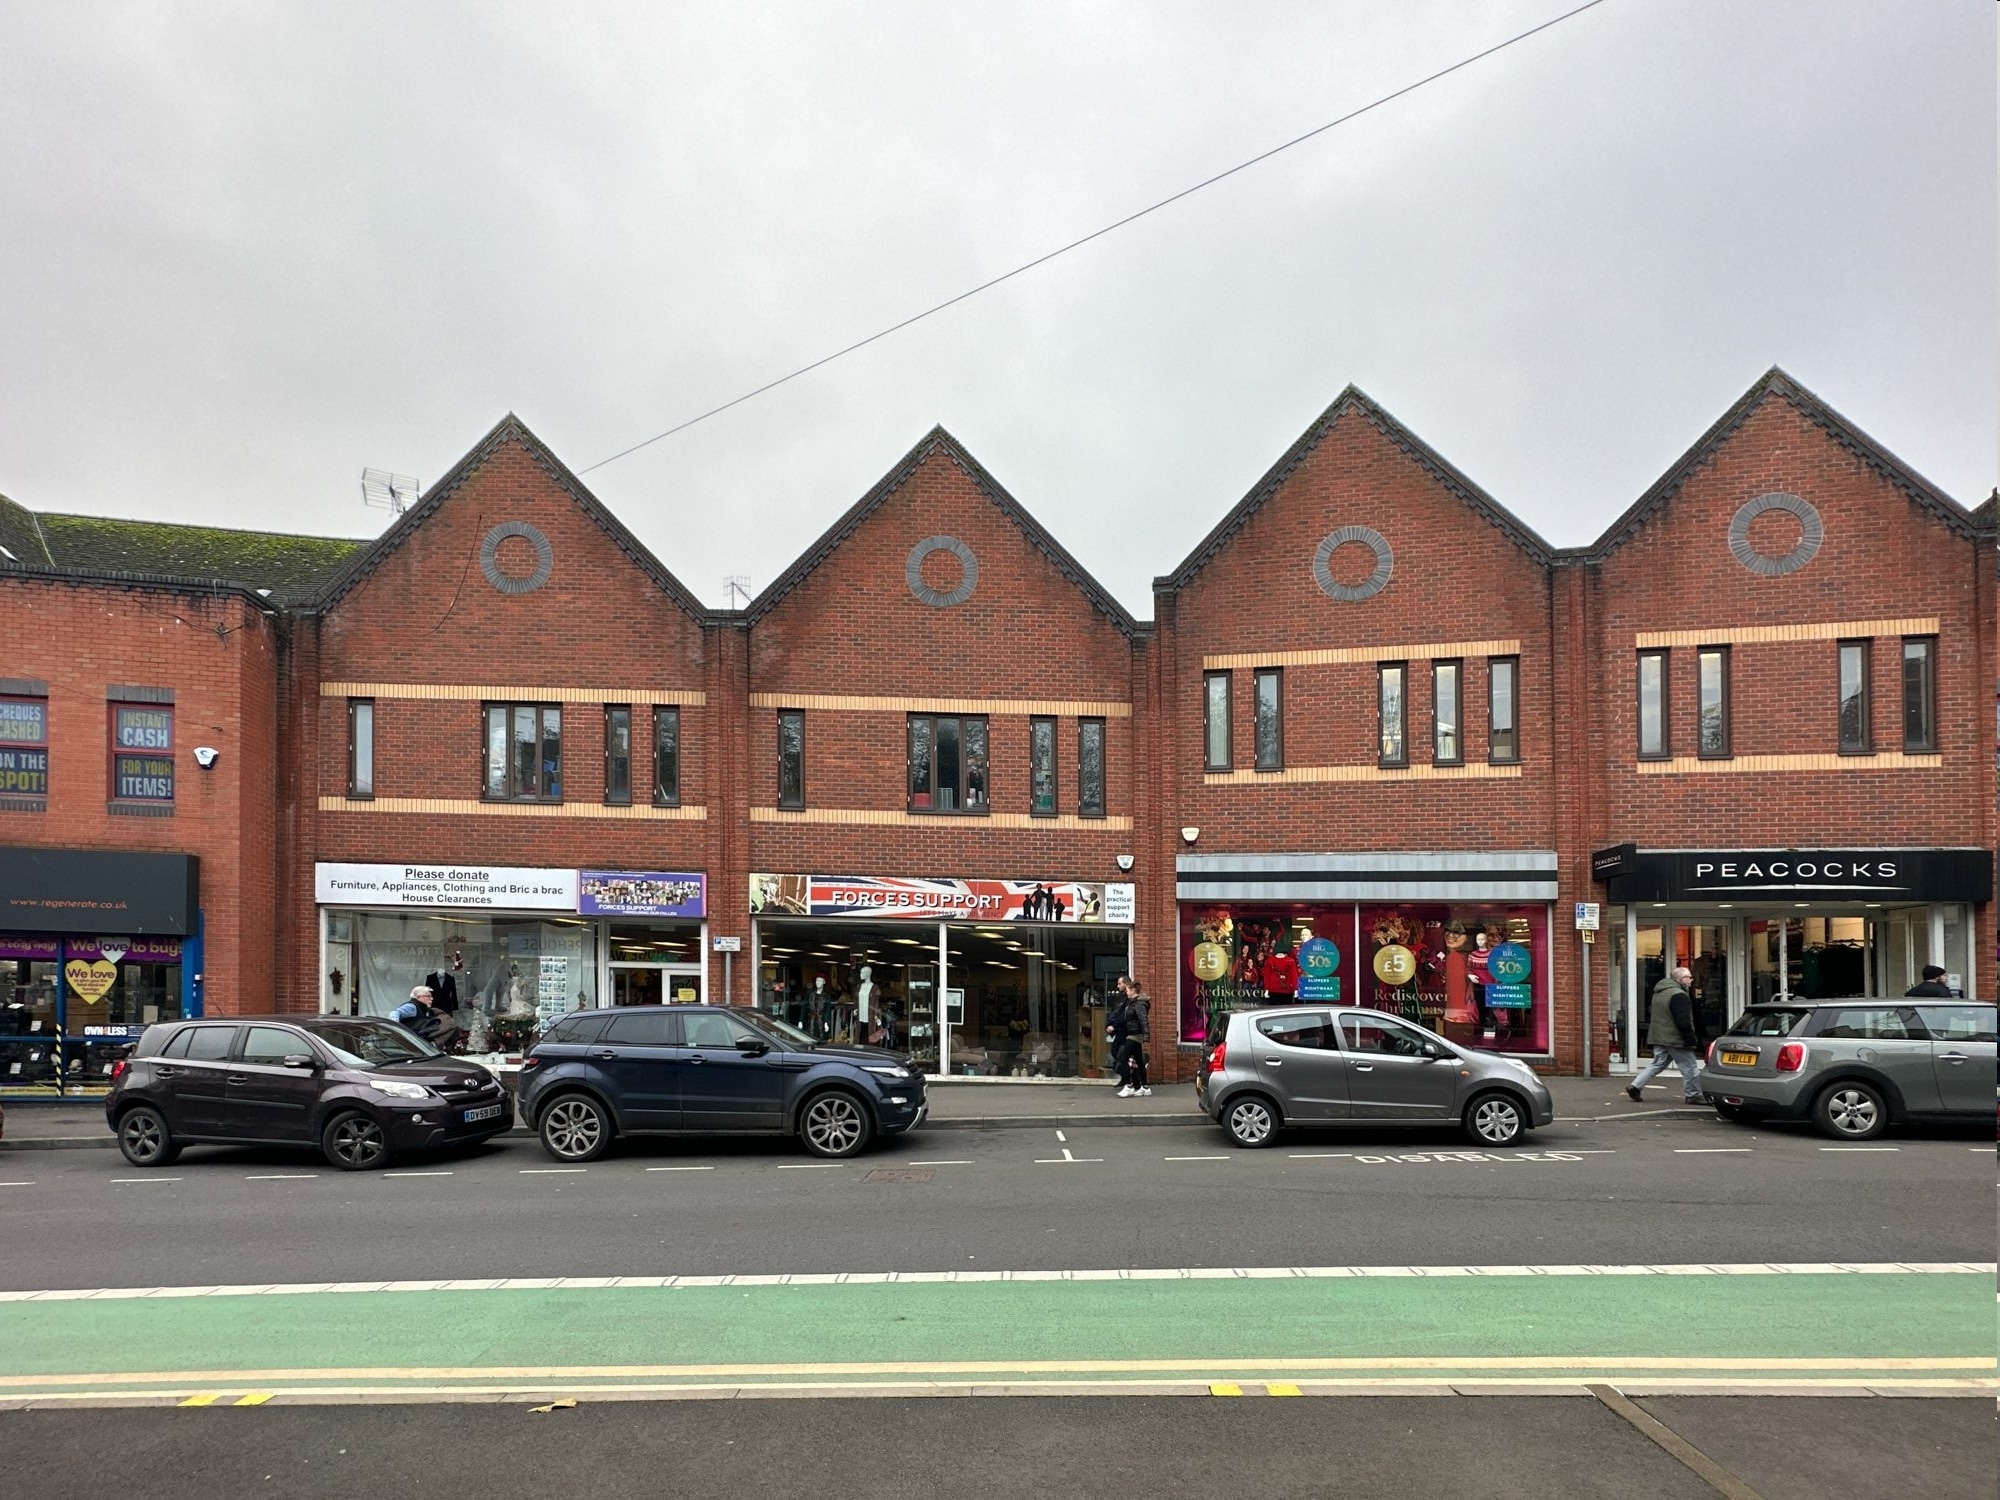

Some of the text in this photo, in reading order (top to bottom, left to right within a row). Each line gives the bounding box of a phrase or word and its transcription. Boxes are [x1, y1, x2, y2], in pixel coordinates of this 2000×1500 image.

[123, 711, 167, 729] INSTANT
[123, 727, 168, 748] CASH
[20, 754, 46, 770] THE
[122, 759, 172, 777] FOR YOUR
[0, 770, 46, 792] SPOT!
[122, 776, 172, 797] ITEMS!
[405, 868, 490, 881] Please donate
[1696, 862, 1897, 878] PEACOCKS
[330, 880, 380, 891] Furniture,
[381, 881, 441, 893] Appliances,
[443, 883, 486, 895] Clothing
[488, 884, 507, 894] and
[509, 884, 530, 894] Bric
[541, 886, 564, 895] brac
[402, 893, 492, 904] House Clearances
[832, 890, 1003, 909] FORCES SUPPORT
[71, 940, 95, 953] We
[99, 940, 129, 952] love
[132, 941, 146, 953] to
[1198, 951, 1220, 969] £5
[1383, 954, 1406, 972] £5
[67, 968, 115, 979] We love
[1195, 984, 1266, 998] Rediscover
[1374, 988, 1449, 1001] Rediscover
[1374, 1002, 1444, 1015] Christmas
[1355, 1152, 1583, 1164] DISABLED
